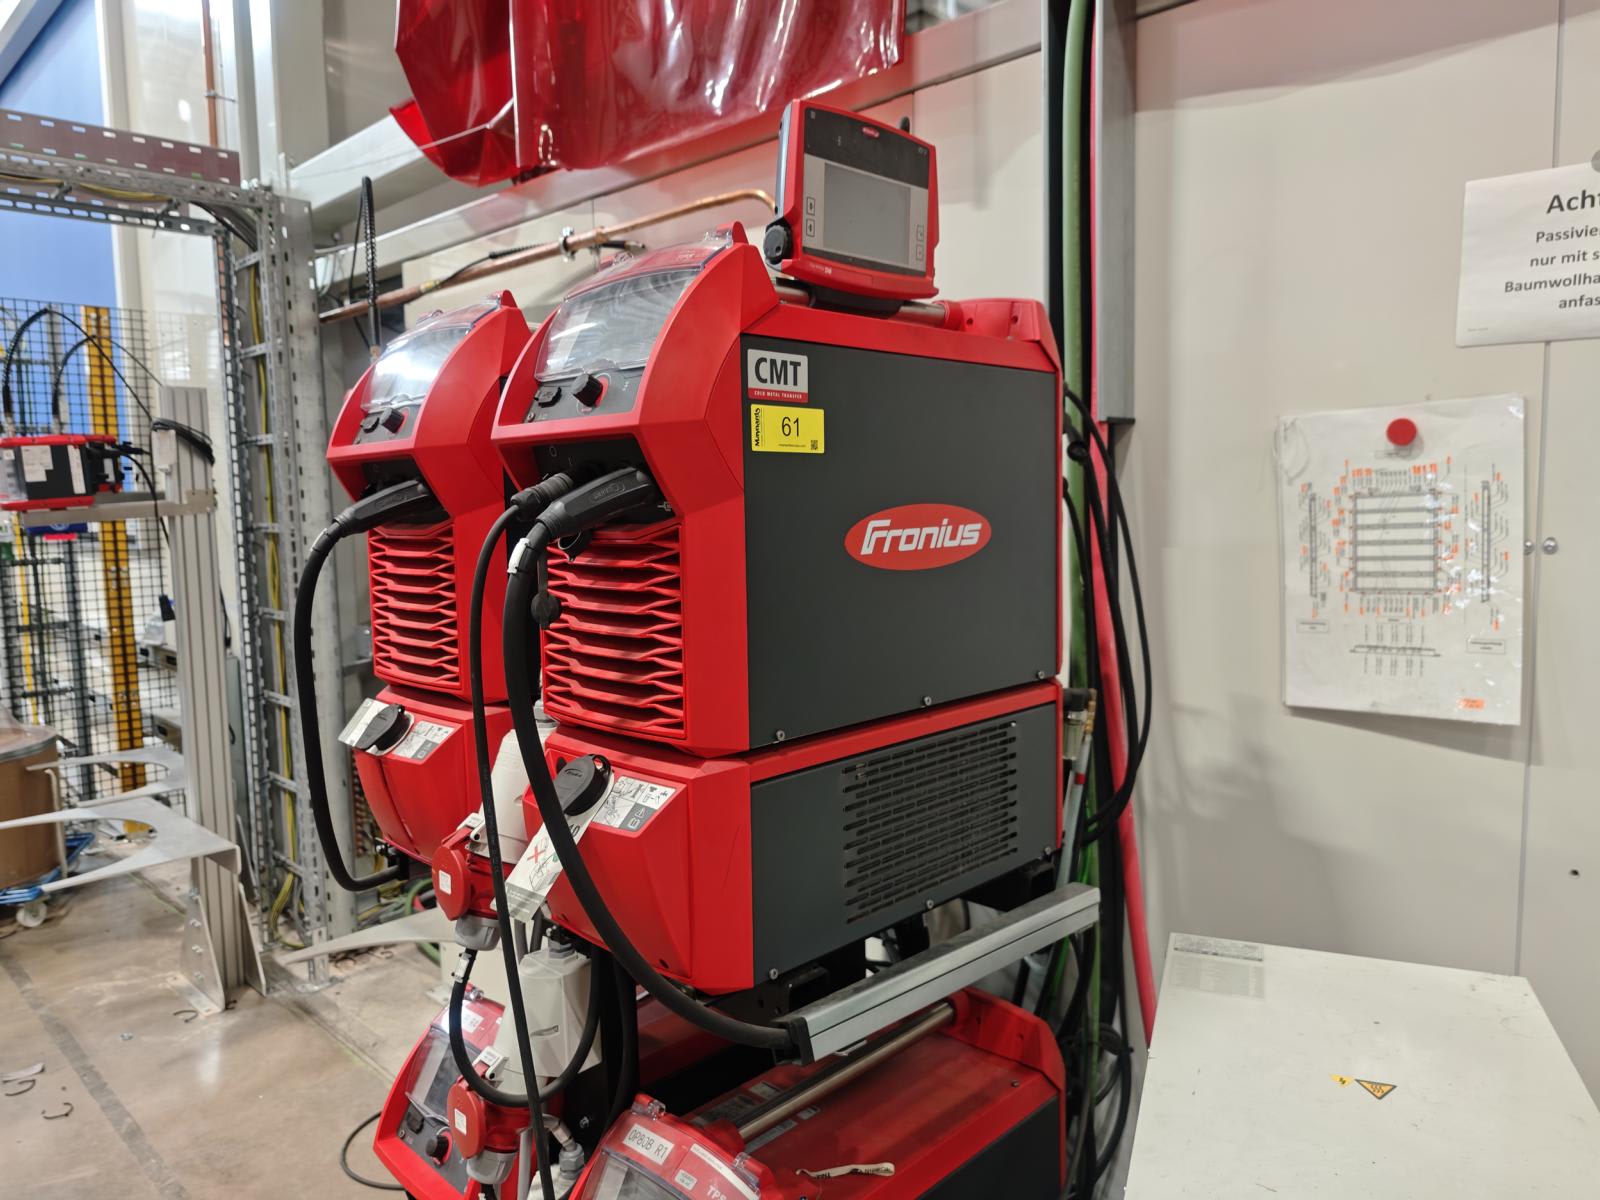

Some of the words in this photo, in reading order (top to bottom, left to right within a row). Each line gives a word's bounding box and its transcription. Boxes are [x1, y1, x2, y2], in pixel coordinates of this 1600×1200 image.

[1546, 189, 1600, 214] Ach
[1536, 225, 1600, 243] Passivie
[1530, 255, 1556, 267] nur
[1561, 250, 1588, 264] mit
[1504, 272, 1600, 293] Baumwollha
[754, 357, 801, 386] CMT
[781, 416, 800, 437] 61
[860, 518, 982, 555] Fronius
